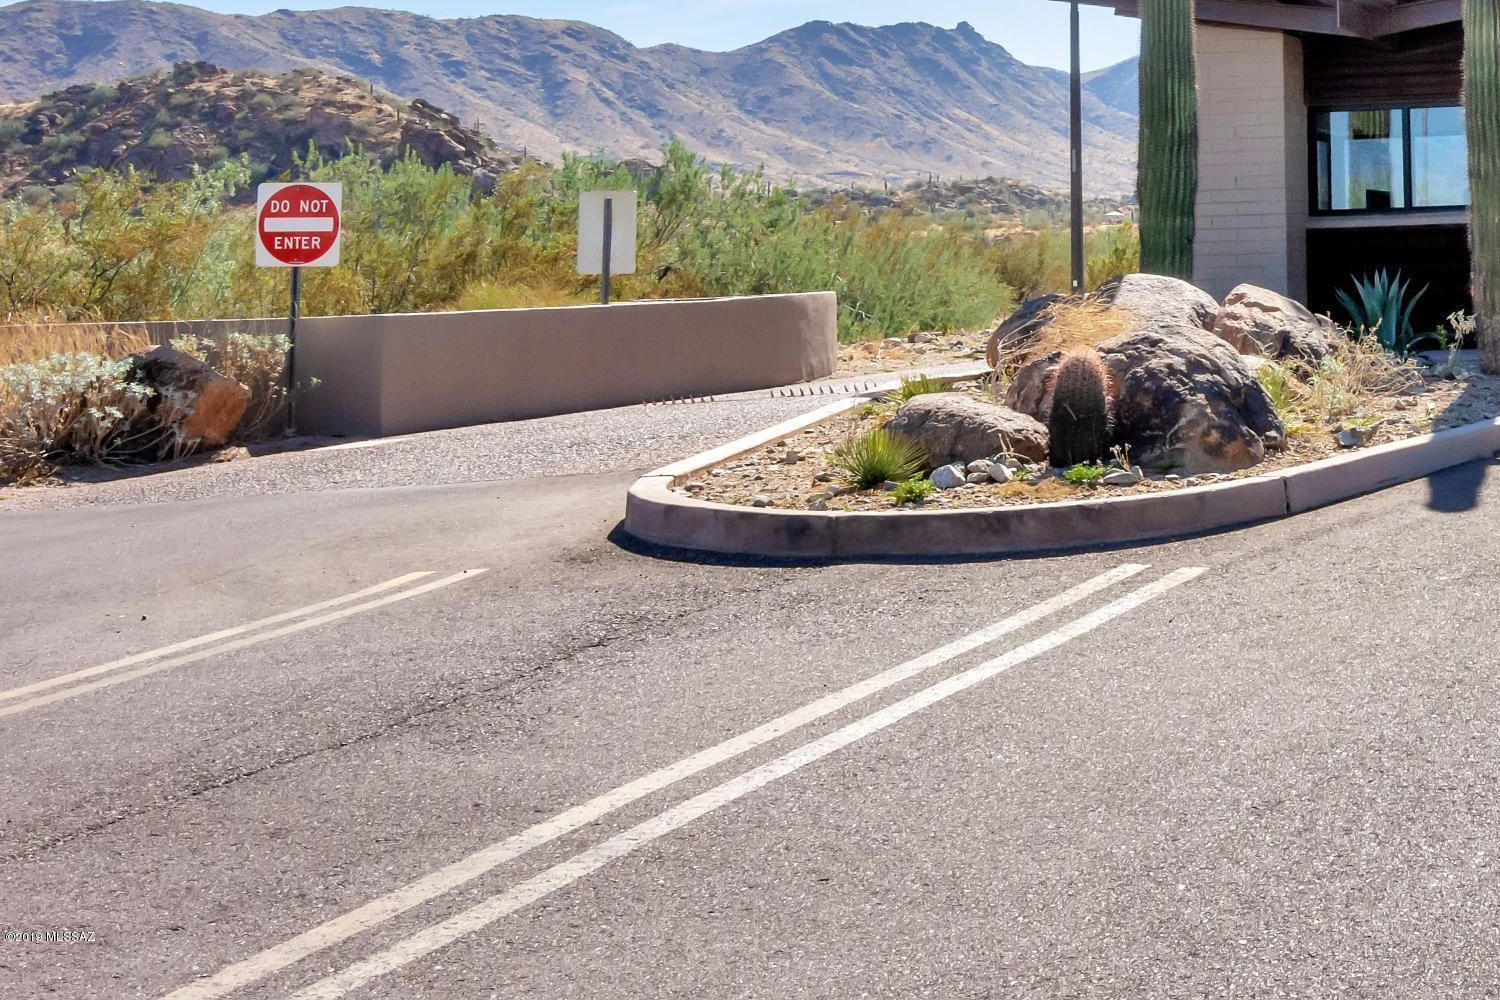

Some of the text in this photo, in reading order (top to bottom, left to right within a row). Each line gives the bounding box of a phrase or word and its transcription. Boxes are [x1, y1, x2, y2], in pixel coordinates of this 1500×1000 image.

[271, 200, 328, 213] DO NOT
[274, 237, 321, 249] ENTER
